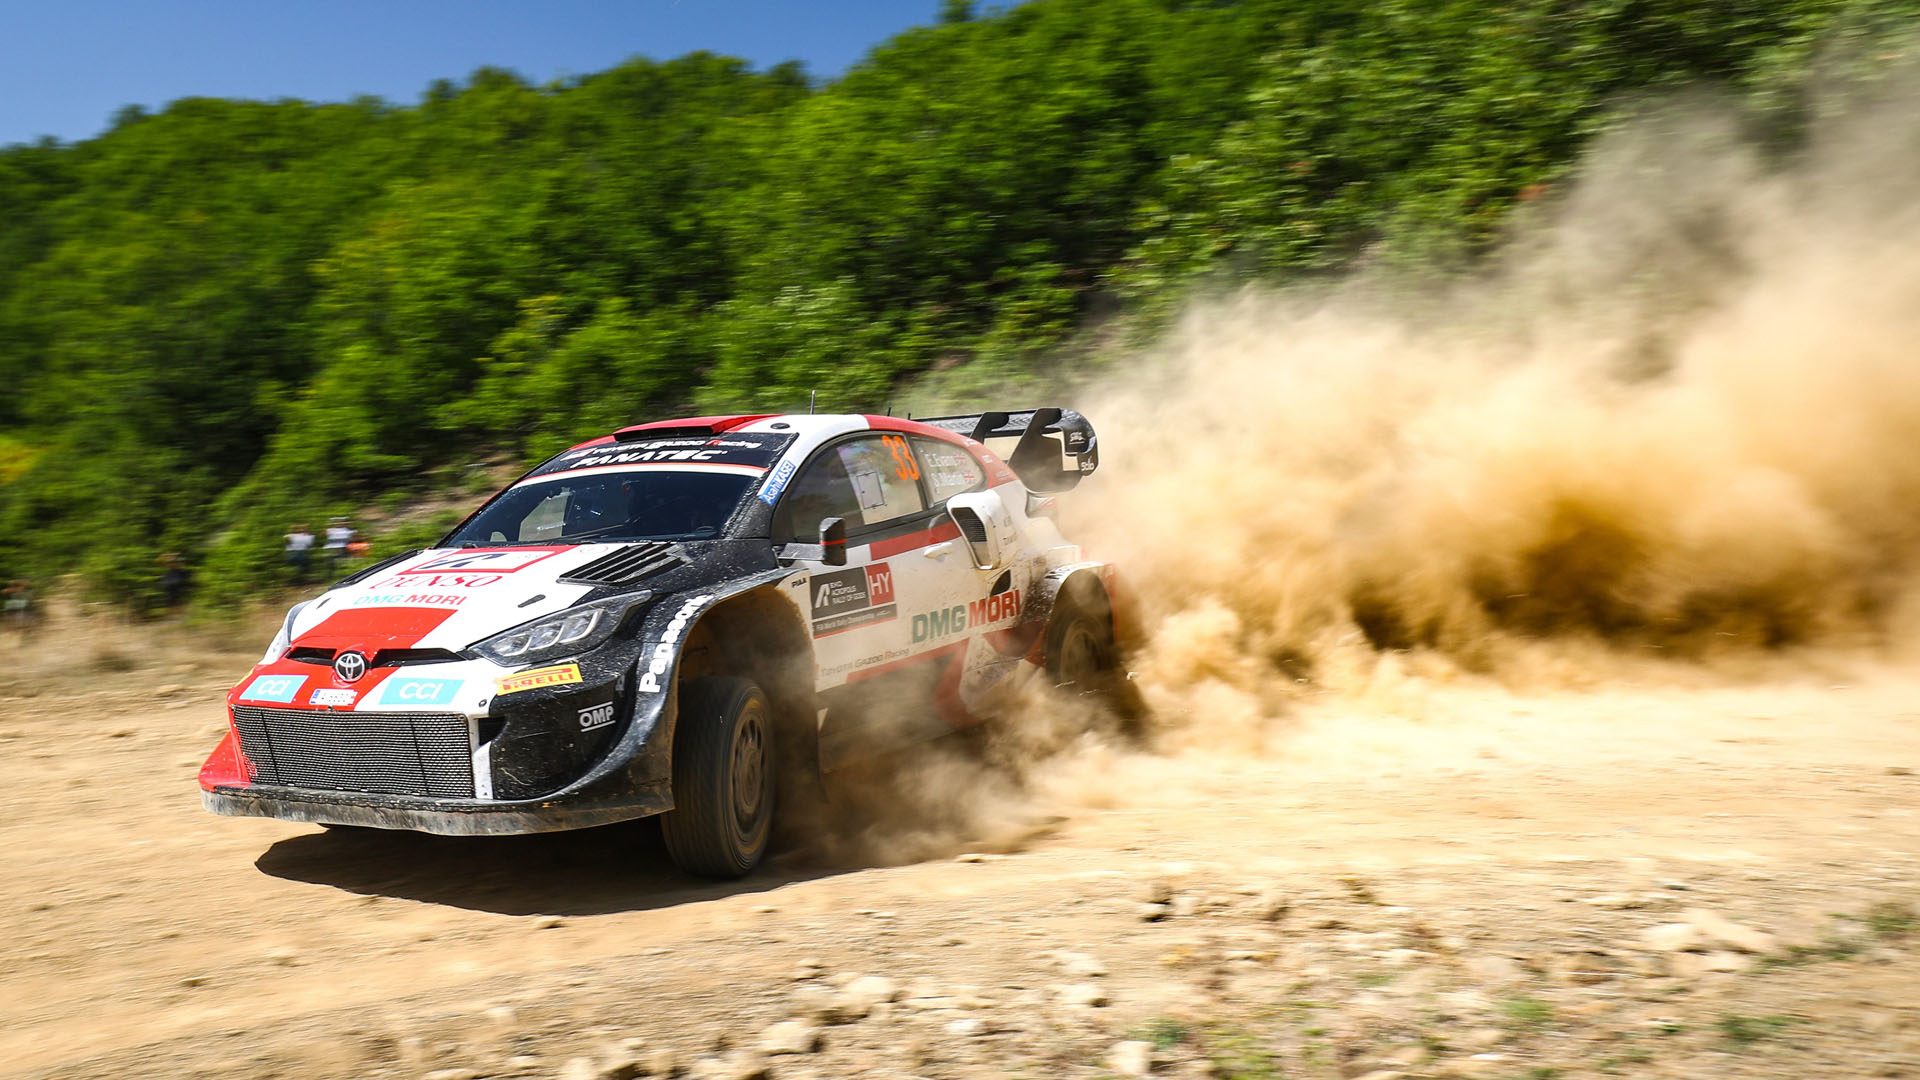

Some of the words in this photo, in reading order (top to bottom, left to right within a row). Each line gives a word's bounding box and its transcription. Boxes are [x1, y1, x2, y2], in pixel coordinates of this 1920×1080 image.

[707, 439, 762, 449] Racing
[570, 450, 720, 468] FANATEC
[882, 435, 919, 480] 33
[369, 575, 503, 589] DENSO
[869, 571, 890, 596] HY
[353, 594, 404, 605] DMG
[405, 594, 468, 605] MORI
[912, 604, 967, 644] DMG
[968, 589, 1021, 628] MORI
[855, 654, 883, 669] GAZOO
[257, 679, 291, 696] CCI
[502, 669, 574, 691] PIRELLI
[400, 681, 443, 700] CCI
[579, 705, 614, 727] OMP
